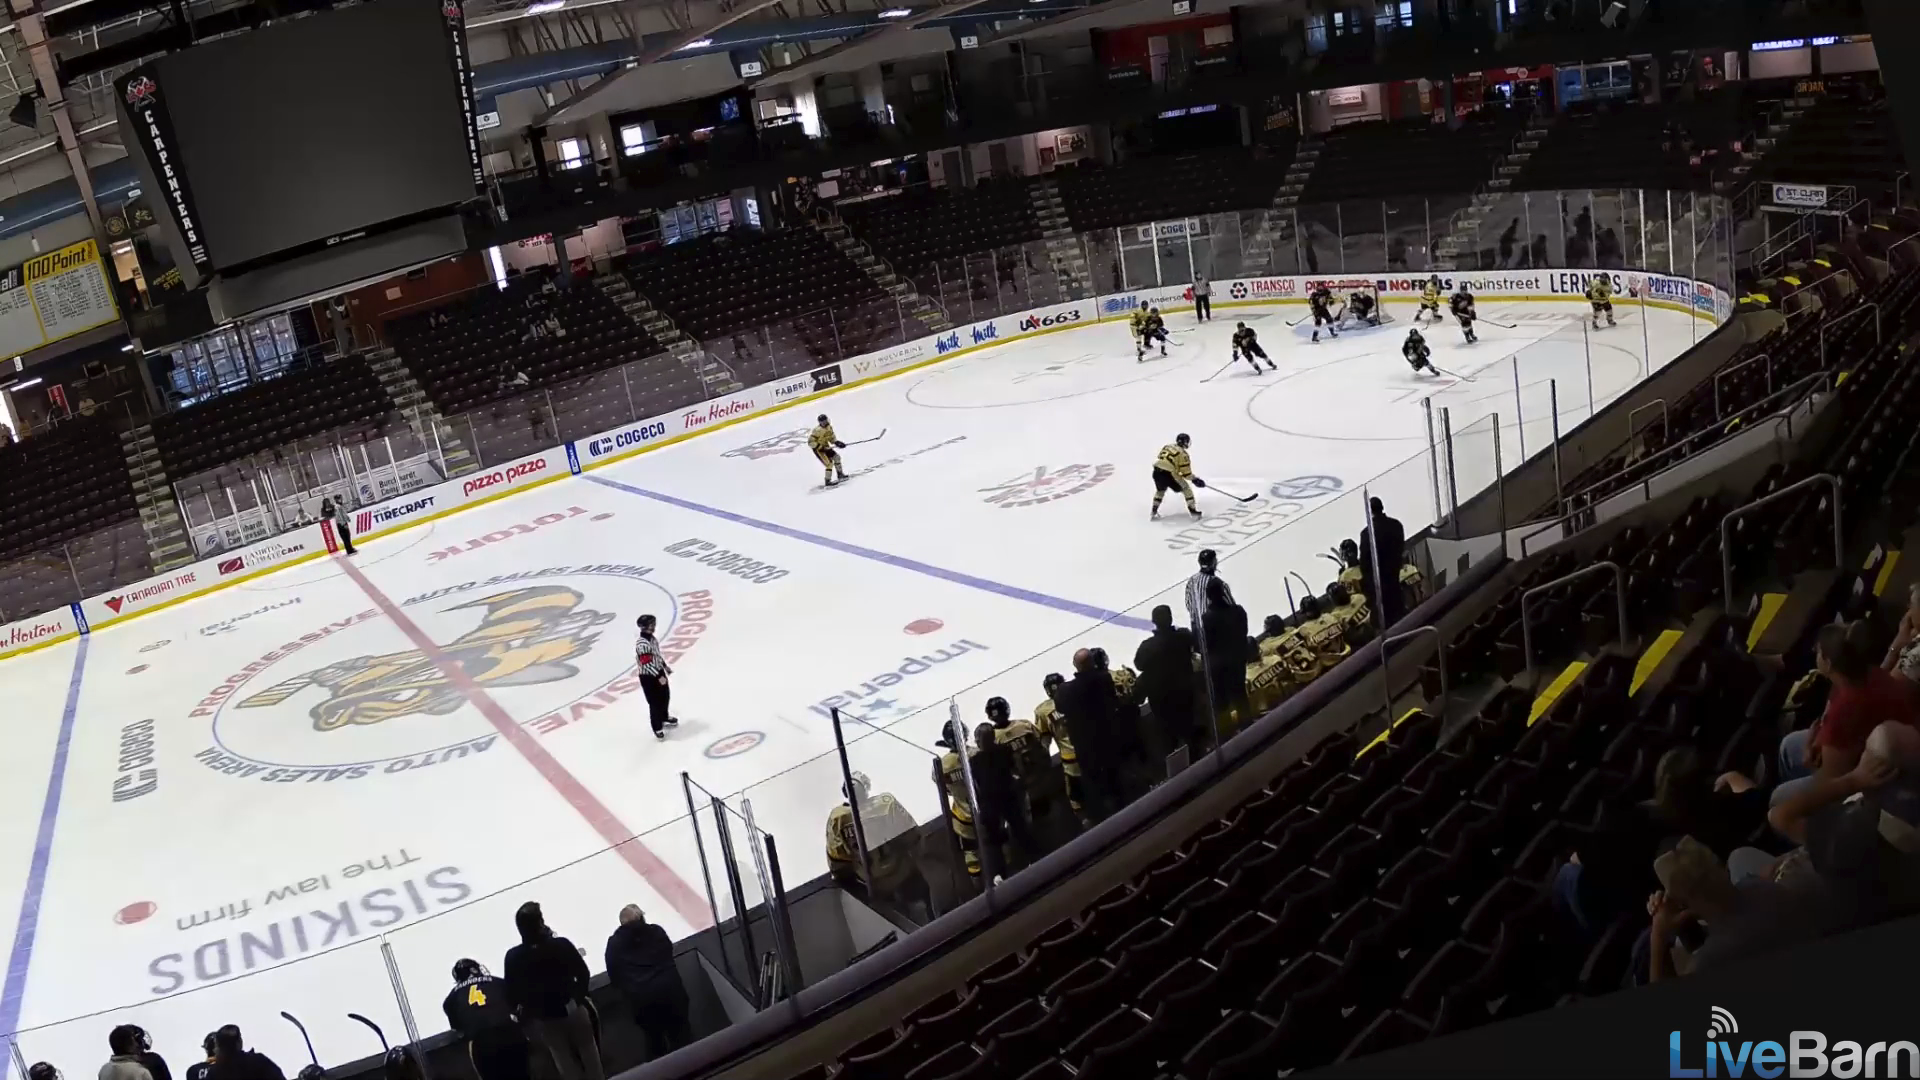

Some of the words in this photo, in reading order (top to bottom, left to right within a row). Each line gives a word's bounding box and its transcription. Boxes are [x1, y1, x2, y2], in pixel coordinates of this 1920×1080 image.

[453, 30, 479, 164] CARPENTERS
[144, 109, 197, 243] CARPENTERS
[28, 256, 50, 281] 100
[52, 246, 87, 273] Point
[1250, 279, 1295, 292] TRANSCO
[1459, 276, 1541, 290] mainstreet
[1550, 272, 1622, 295] LERNS
[1041, 309, 1081, 327] 663
[775, 381, 808, 398] FABBRI
[817, 371, 838, 385] TILE
[682, 409, 707, 429] Tim
[709, 398, 755, 422] Hortons
[463, 471, 504, 497] pizza
[506, 457, 547, 485] pizza
[373, 496, 437, 524] TIRECRAFT
[126, 579, 175, 604] CANADIAN
[176, 571, 197, 589] TIRE
[401, 581, 477, 607] AUTO
[480, 564, 573, 587] SALES
[571, 564, 656, 577] ARENA
[11, 620, 63, 646] Hortons
[187, 608, 378, 718] PROGRESSIVE
[531, 589, 714, 735] PROGRESIVE
[808, 639, 991, 720] Imperial
[194, 746, 268, 779] ARENA
[384, 735, 500, 774] AUTO
[260, 763, 378, 783] SALES
[341, 848, 422, 879] The
[264, 874, 332, 906] law
[148, 865, 472, 995] SISKINDS
[176, 897, 253, 932] firm
[468, 984, 487, 1006] 4
